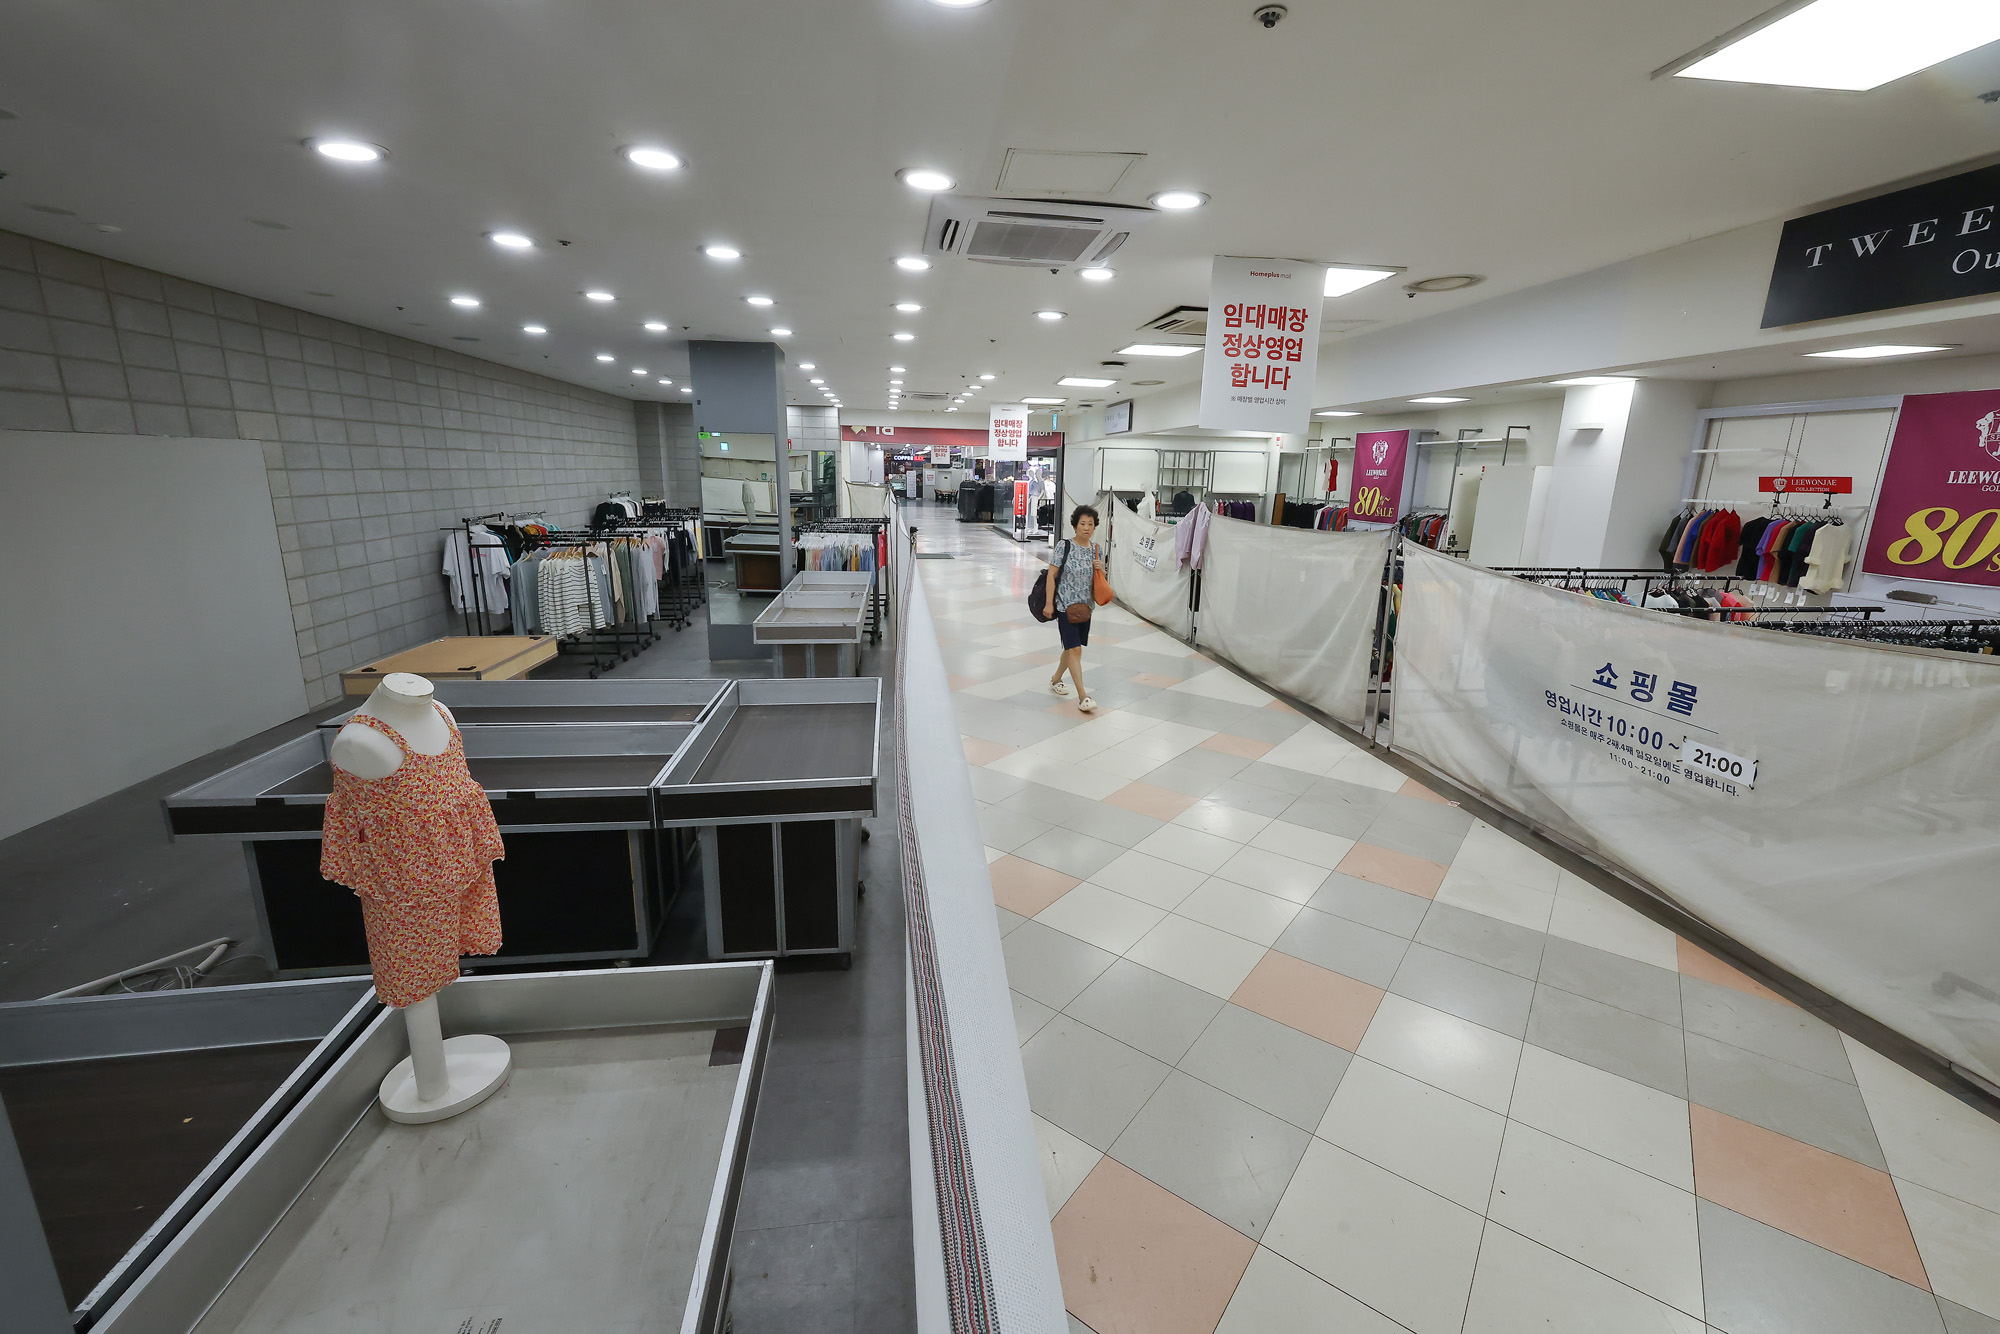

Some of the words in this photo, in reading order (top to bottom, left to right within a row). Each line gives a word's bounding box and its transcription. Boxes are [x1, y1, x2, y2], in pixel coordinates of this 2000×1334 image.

[1250, 270, 1280, 278] Homeplus
[1223, 303, 1308, 332] 임대매장
[1222, 333, 1303, 362] 정상영업
[1230, 363, 1291, 391] 합니다
[993, 419, 1023, 428] 임대매장
[994, 429, 1022, 438] 정상영업
[997, 439, 1018, 447] 합니다
[1374, 507, 1395, 517] SALE
[1545, 689, 1602, 728] 영업시간
[1693, 748, 1743, 777] 21:00
[1560, 718, 1588, 736] 쇼핑몰은
[1589, 730, 1605, 742] 매주
[1635, 749, 1681, 774] 일요일에도
[1683, 768, 1740, 797] 영업합니다.
